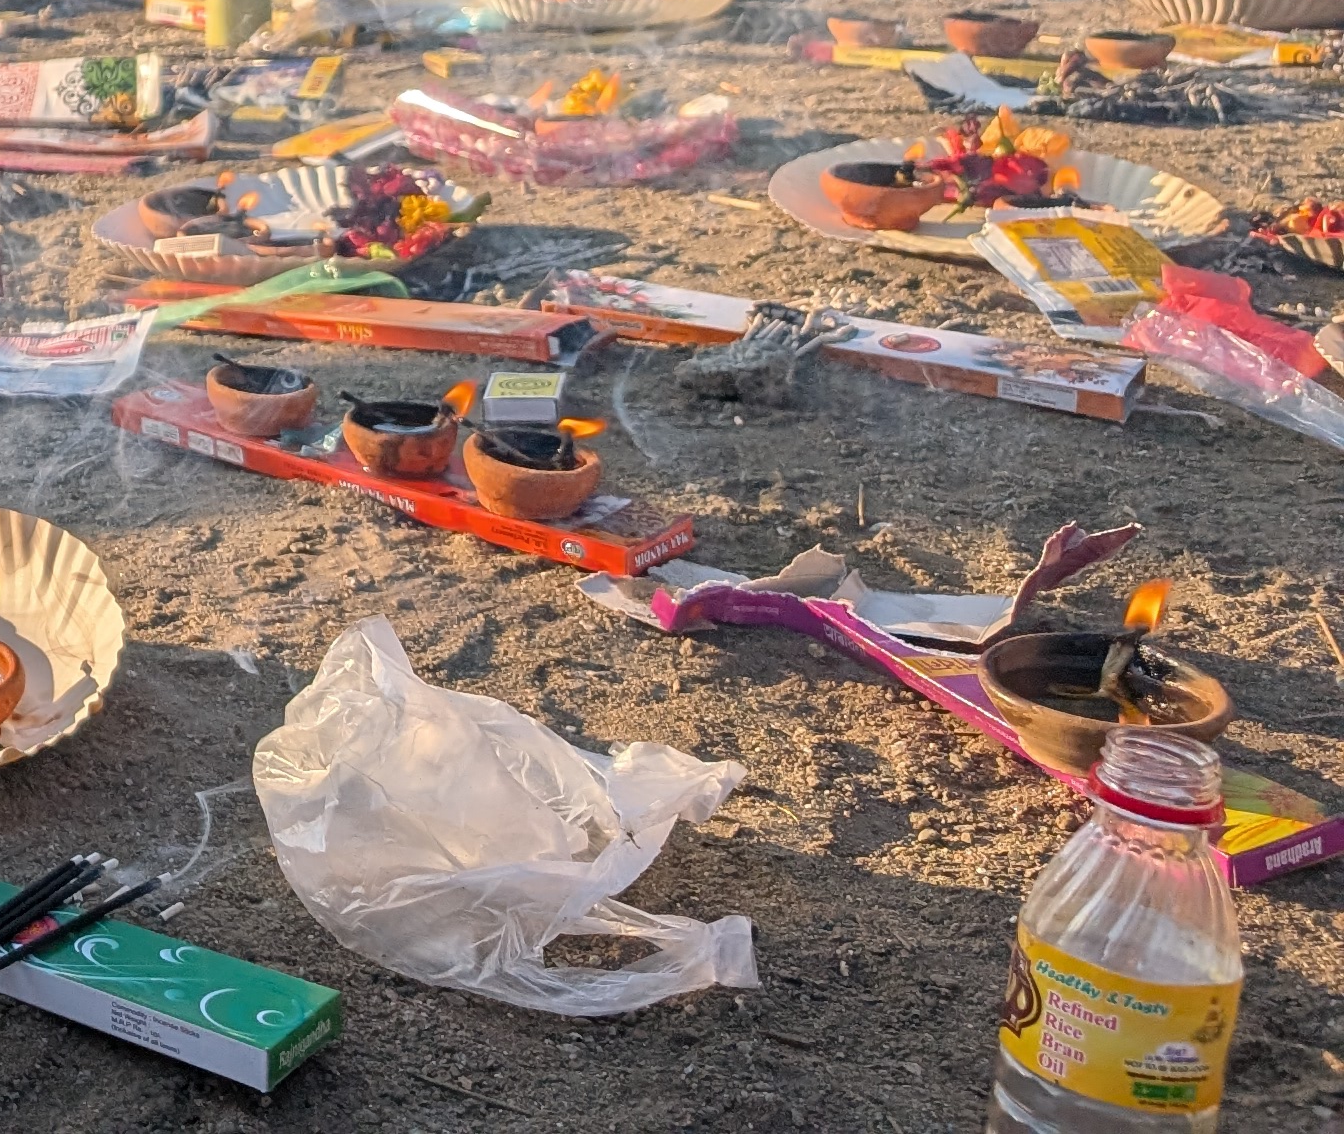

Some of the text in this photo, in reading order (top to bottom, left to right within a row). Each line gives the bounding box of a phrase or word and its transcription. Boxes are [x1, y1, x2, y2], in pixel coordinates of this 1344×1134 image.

[1265, 835, 1323, 871] Aradhana
[1036, 960, 1101, 1000] Healthy
[1121, 993, 1170, 1017] Tasty
[1044, 1011, 1084, 1040] Rice
[1047, 990, 1118, 1032] Refined
[1038, 1052, 1065, 1076] Oil
[1041, 1032, 1085, 1064] Bran
